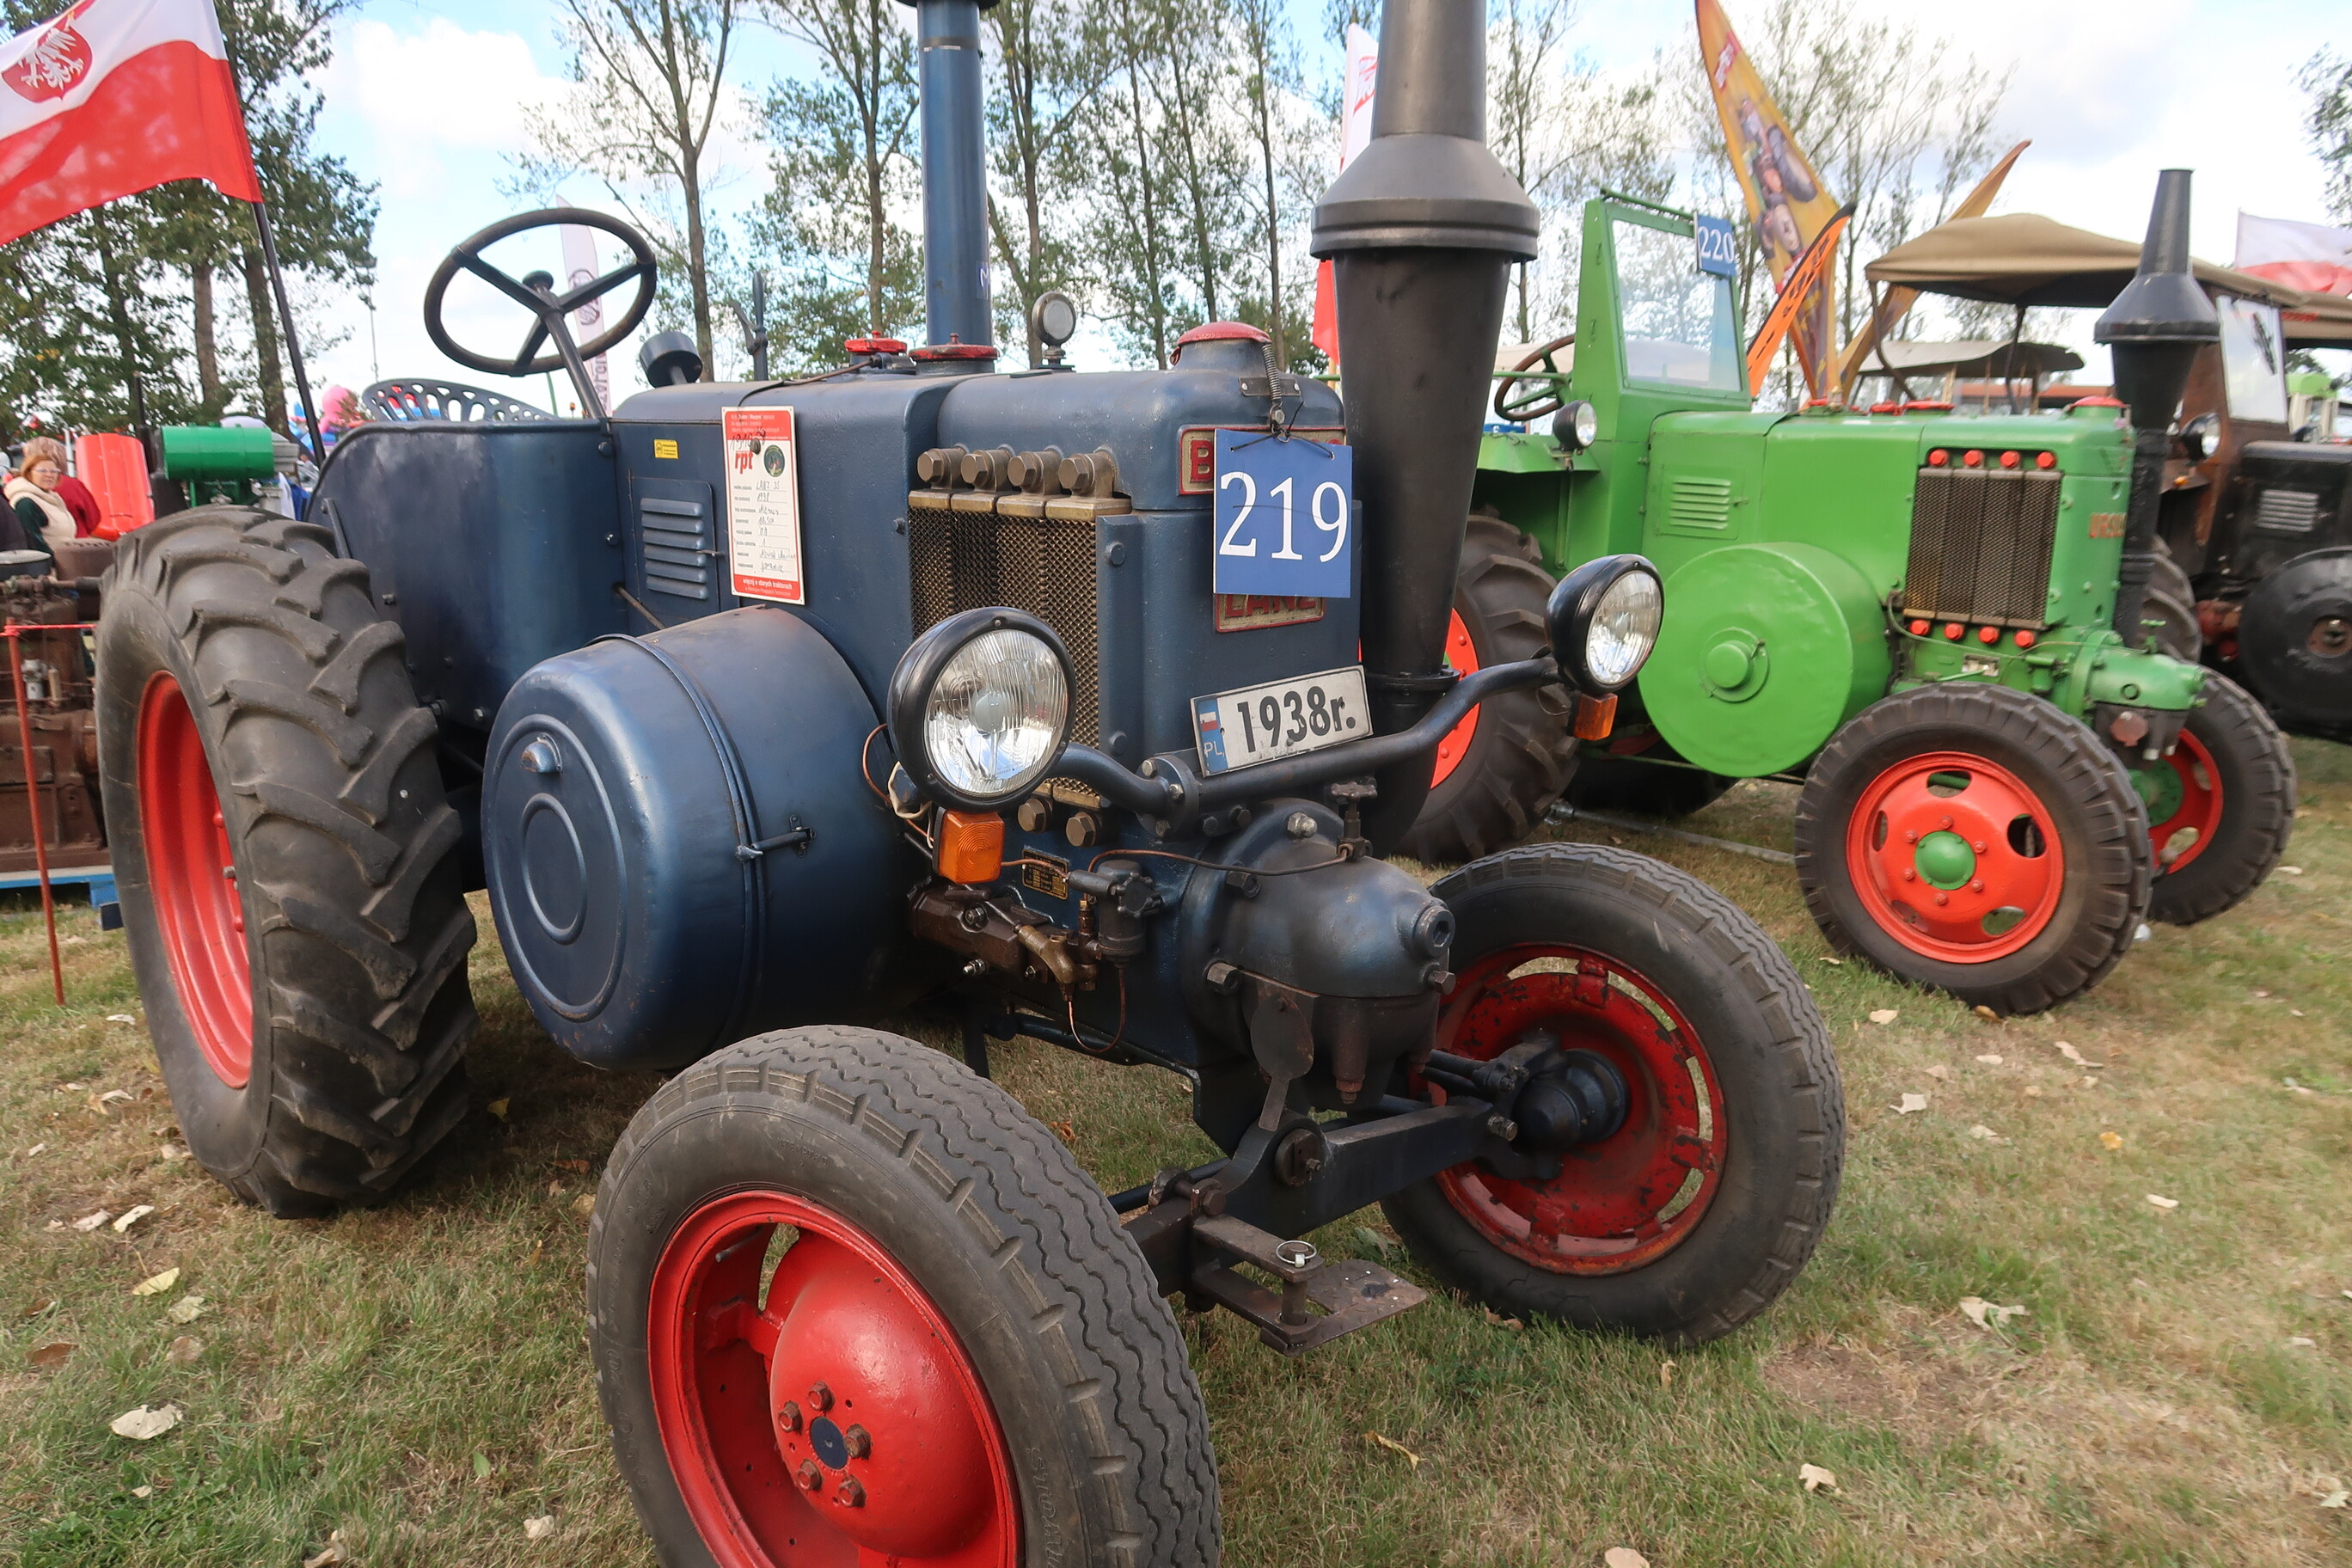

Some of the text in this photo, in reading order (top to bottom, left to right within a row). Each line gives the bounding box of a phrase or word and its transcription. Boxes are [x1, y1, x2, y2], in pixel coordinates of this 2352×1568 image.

[1698, 226, 1735, 264] 220
[735, 451, 754, 474] rpt
[1218, 470, 1349, 563] 219
[1237, 685, 1357, 753] 1938r.
[1204, 741, 1224, 757] PL
